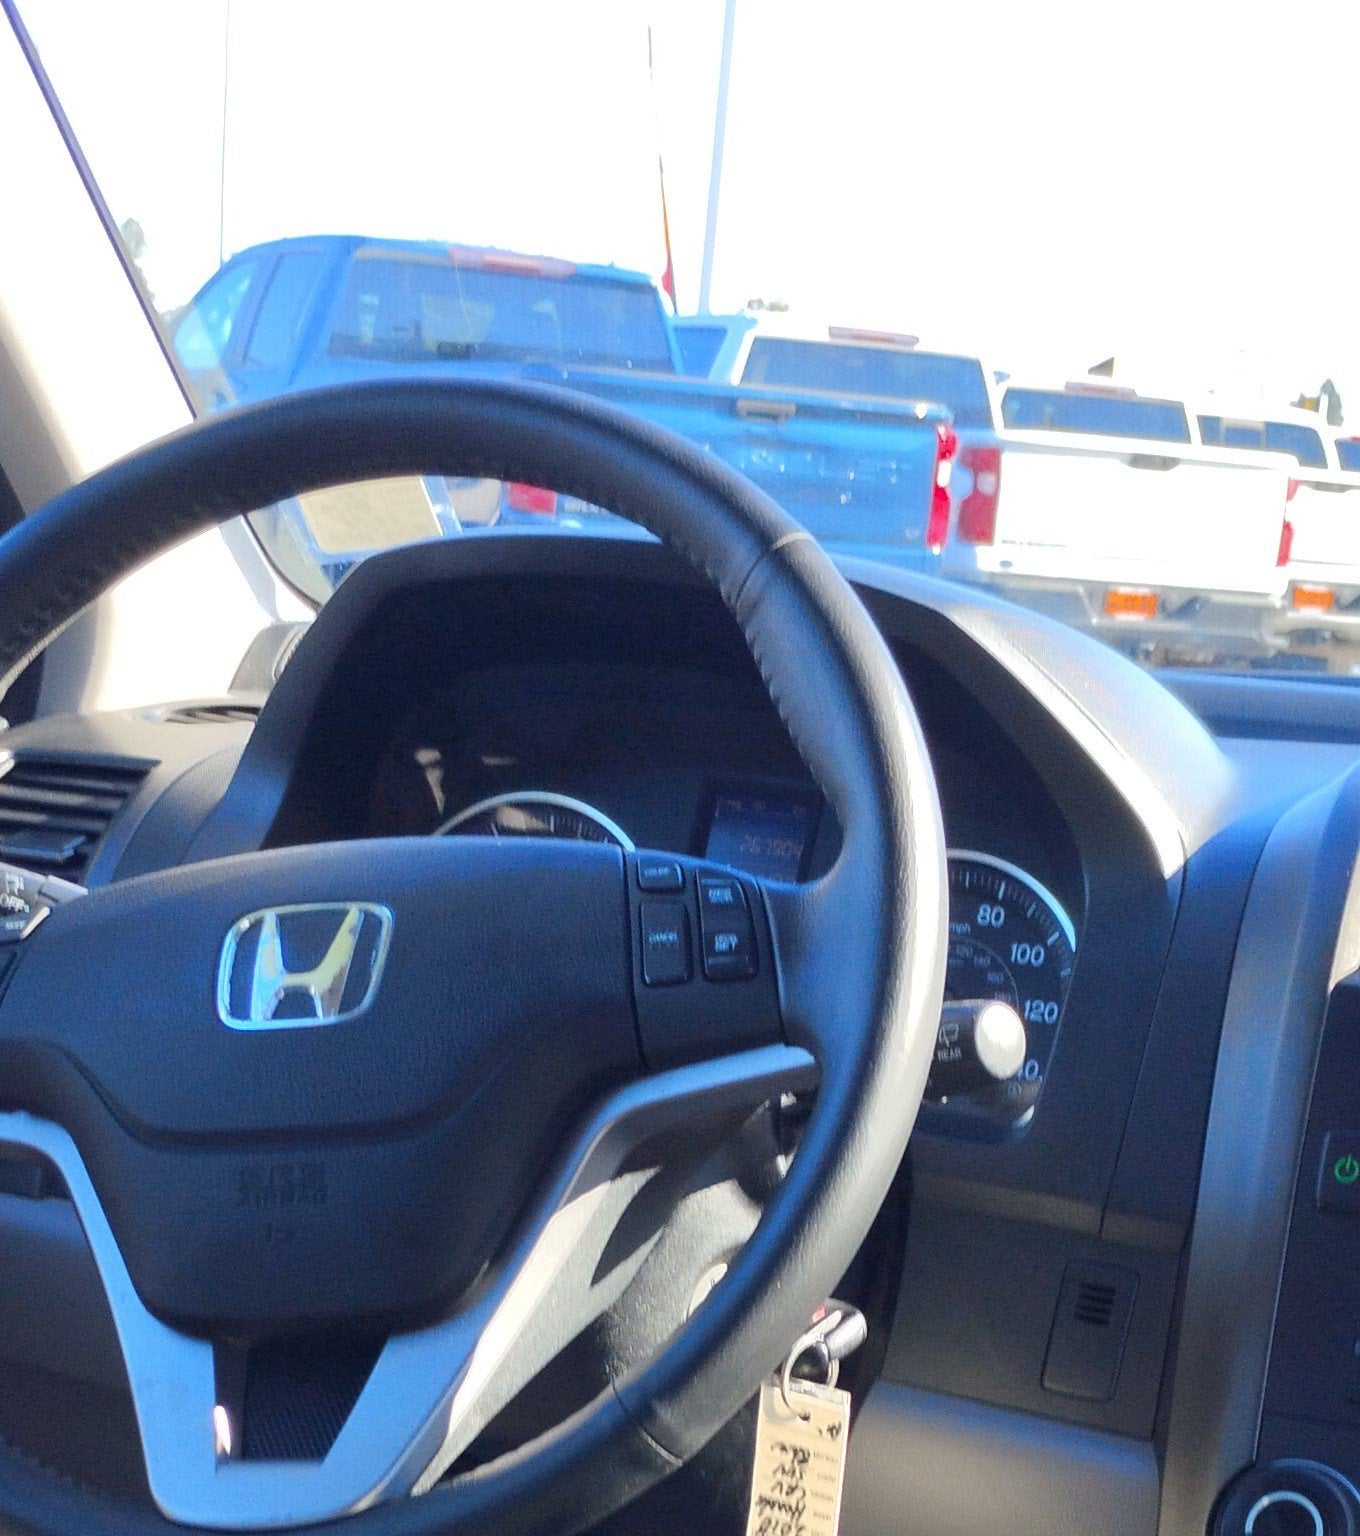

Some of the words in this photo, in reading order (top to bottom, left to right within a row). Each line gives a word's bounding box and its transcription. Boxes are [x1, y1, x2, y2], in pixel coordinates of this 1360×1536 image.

[977, 904, 1005, 928] 80
[1010, 943, 1045, 967] 100
[1024, 1000, 1058, 1024] 120
